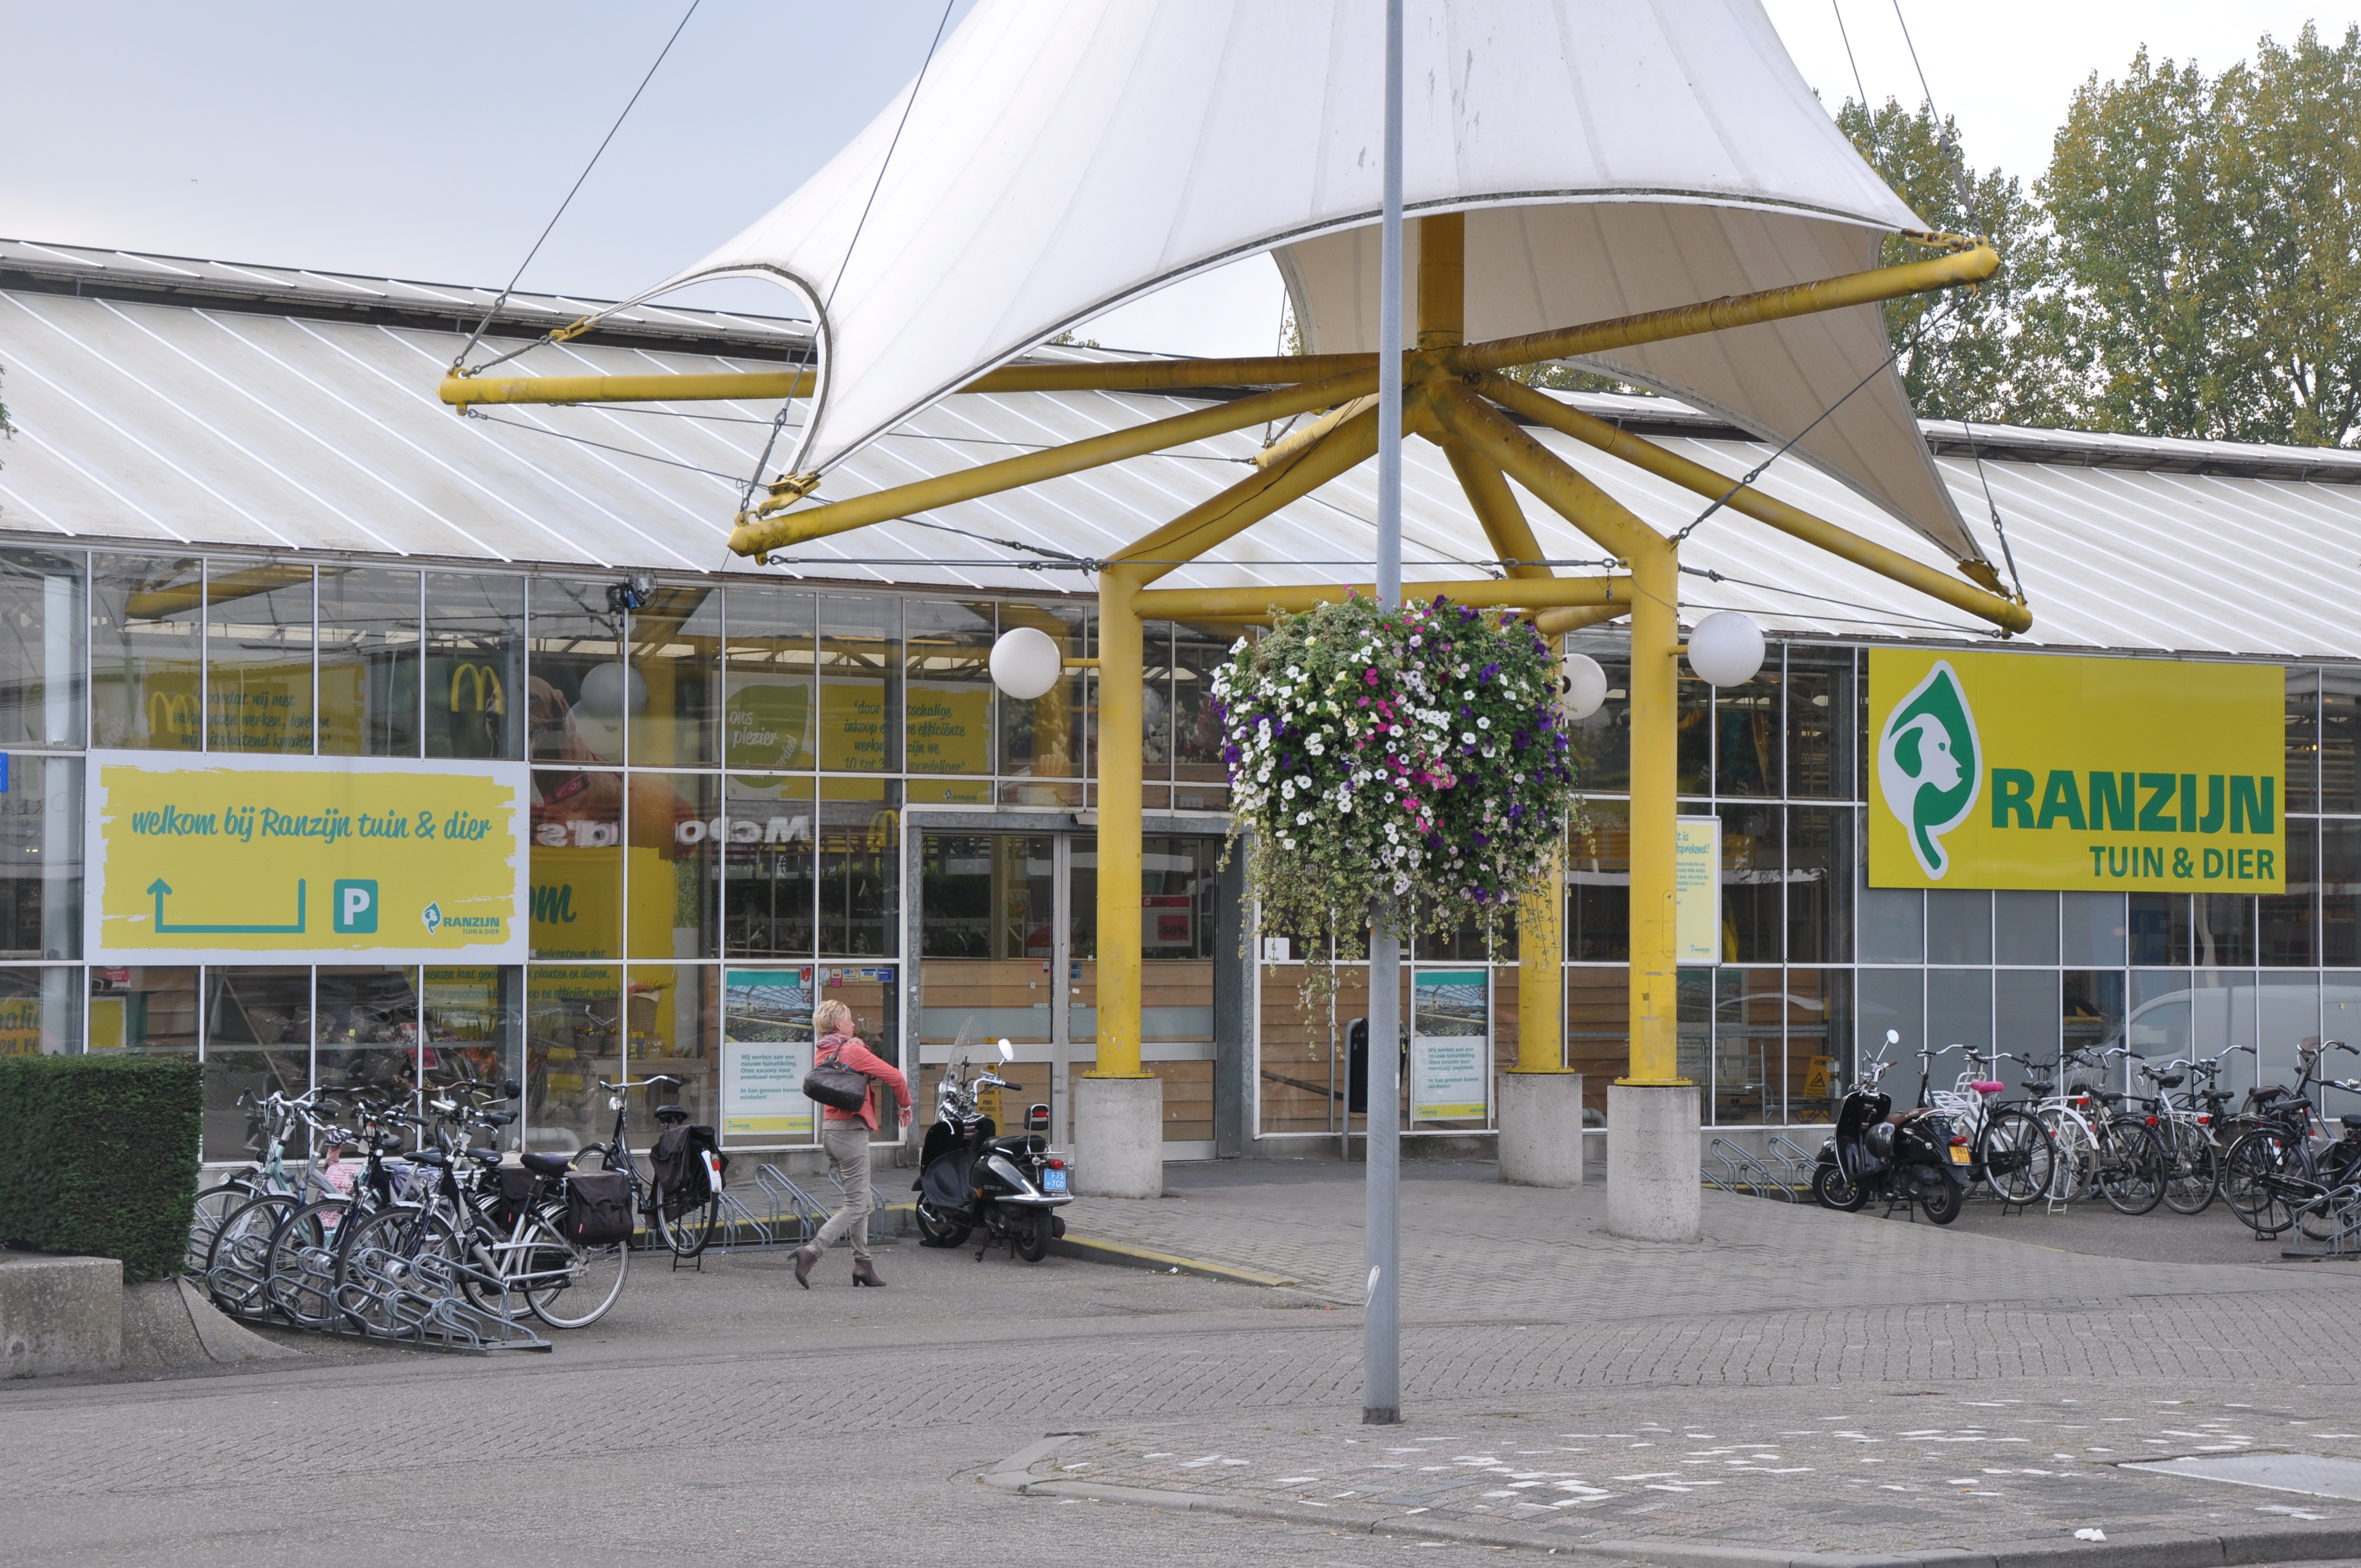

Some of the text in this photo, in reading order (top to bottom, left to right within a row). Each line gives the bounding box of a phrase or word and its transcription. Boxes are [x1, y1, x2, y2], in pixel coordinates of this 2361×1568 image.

[272, 694, 295, 707] met
[730, 711, 753, 726] ons
[845, 719, 877, 737] inkoop
[733, 726, 778, 748] plezier
[1991, 768, 2274, 834] RANZIJN
[132, 804, 492, 844] welkom bij Ranzijn tuin & dier
[2089, 846, 2275, 879] TUIN & DIER
[344, 888, 369, 925] P
[443, 917, 499, 927] RANZIJN
[458, 968, 476, 979] laat
[534, 967, 568, 981] planten
[569, 970, 579, 979] en
[1052, 1171, 1064, 1179] F75
[1052, 1180, 1064, 1188] 7GD
